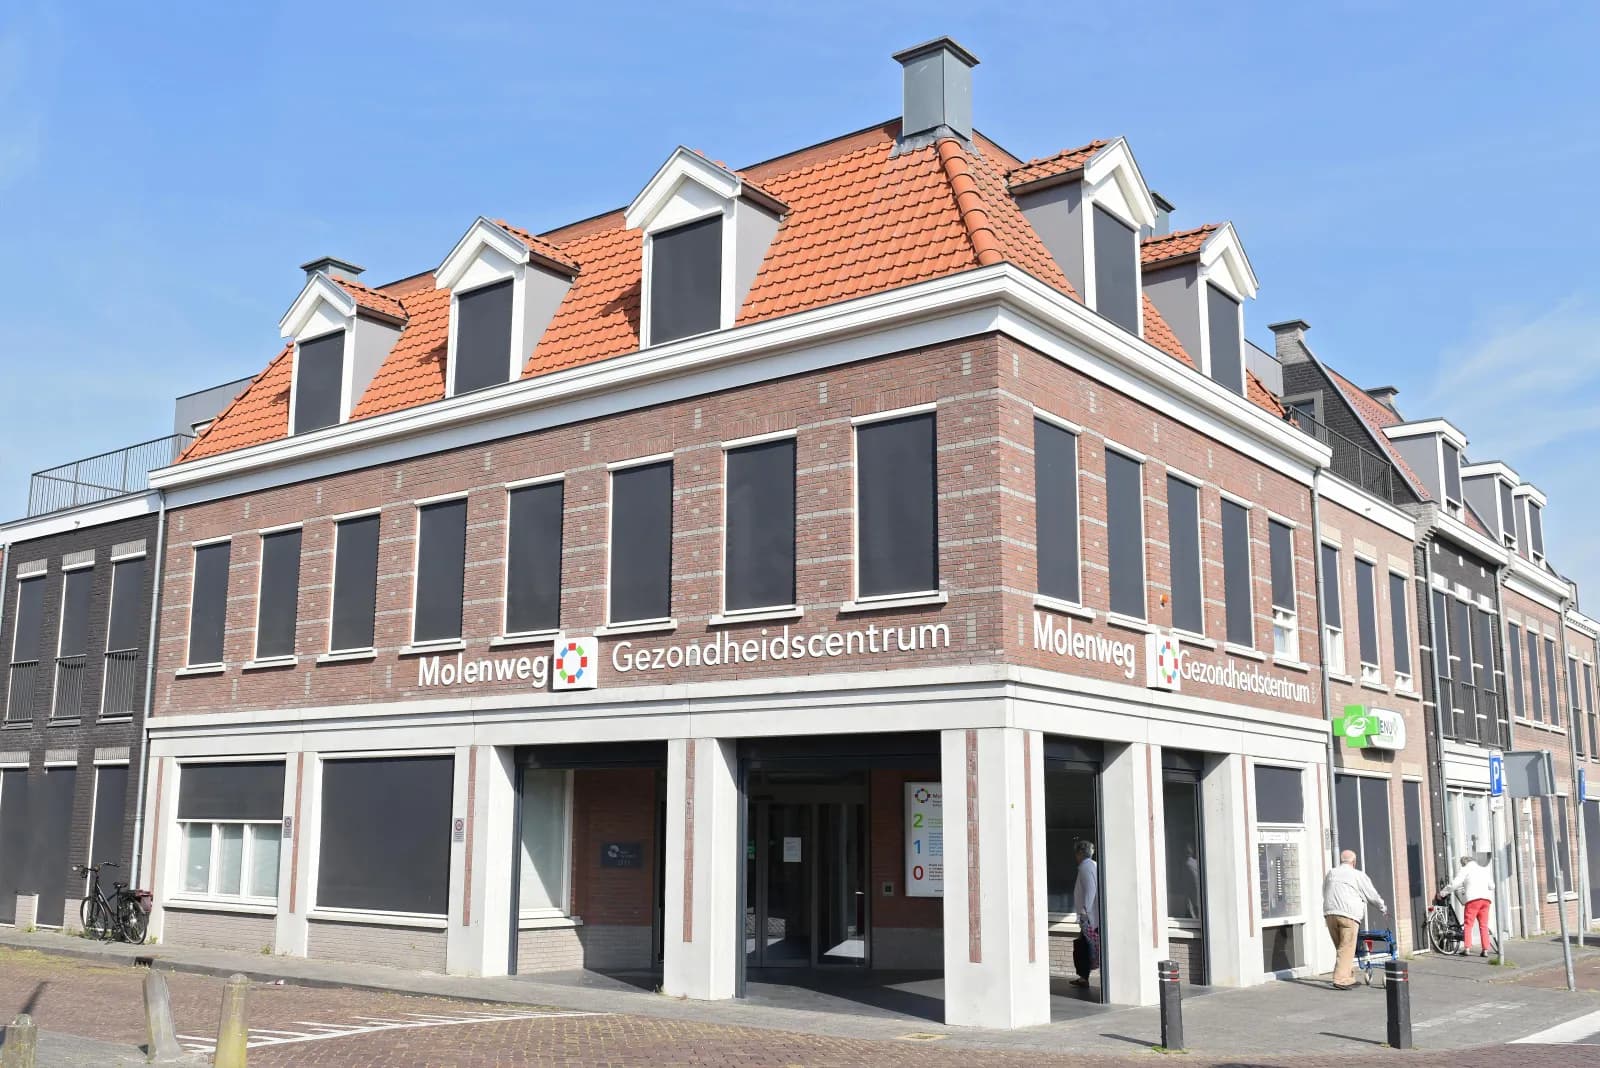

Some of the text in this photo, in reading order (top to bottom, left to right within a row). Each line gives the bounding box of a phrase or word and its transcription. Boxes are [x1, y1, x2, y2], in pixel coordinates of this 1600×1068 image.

[612, 623, 951, 672] Gezondheidscentrum
[1033, 612, 1135, 679] Molenweg
[418, 652, 549, 688] Molenweg
[1179, 649, 1311, 704] Gezondheidscentrum
[1493, 761, 1500, 791] P
[913, 813, 923, 828] 2
[913, 839, 921, 855] 1
[913, 865, 924, 880] 0
